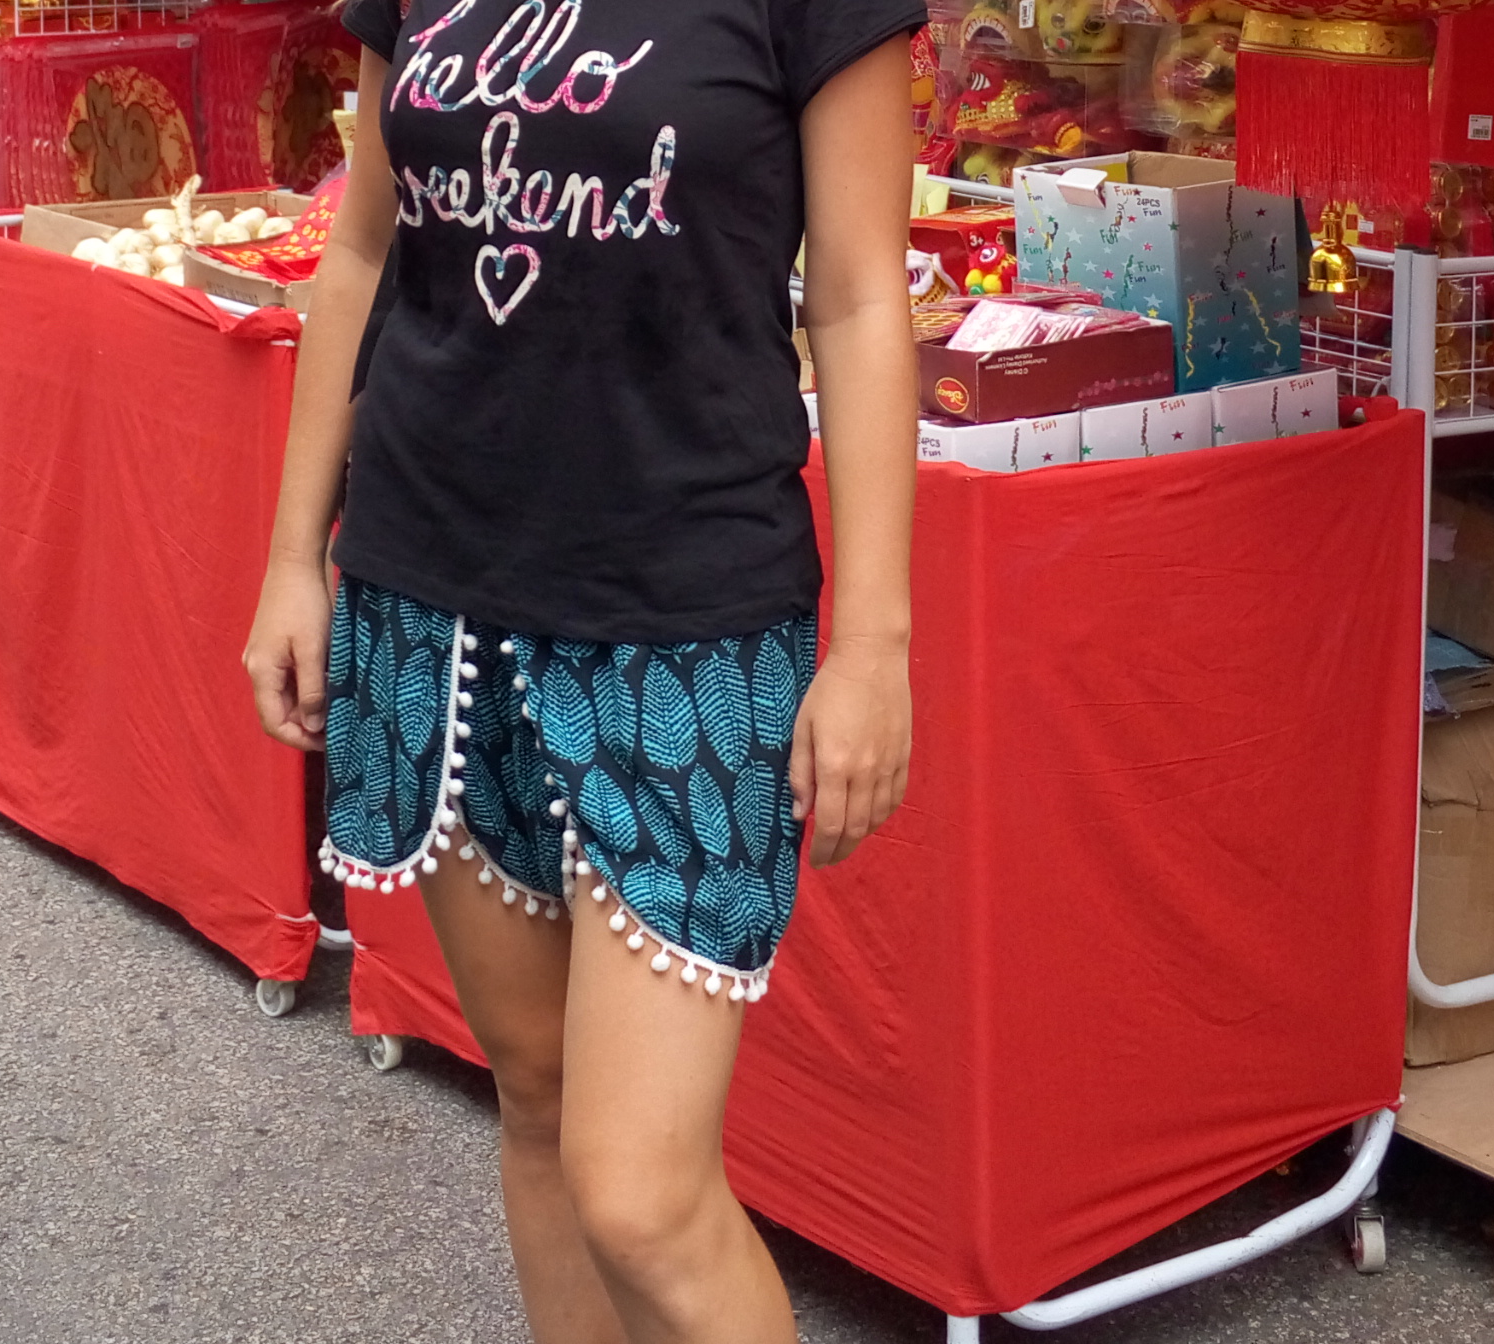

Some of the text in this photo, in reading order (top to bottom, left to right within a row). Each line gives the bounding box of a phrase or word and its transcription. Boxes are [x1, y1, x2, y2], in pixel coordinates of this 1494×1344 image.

[396, 110, 681, 242] weekend
[1136, 197, 1161, 209] 24PCS
[1142, 207, 1163, 217] Fun
[1004, 368, 1023, 376] Disney
[1289, 377, 1315, 393] Fun
[1159, 398, 1186, 413] Fun
[1032, 419, 1058, 434] Fun
